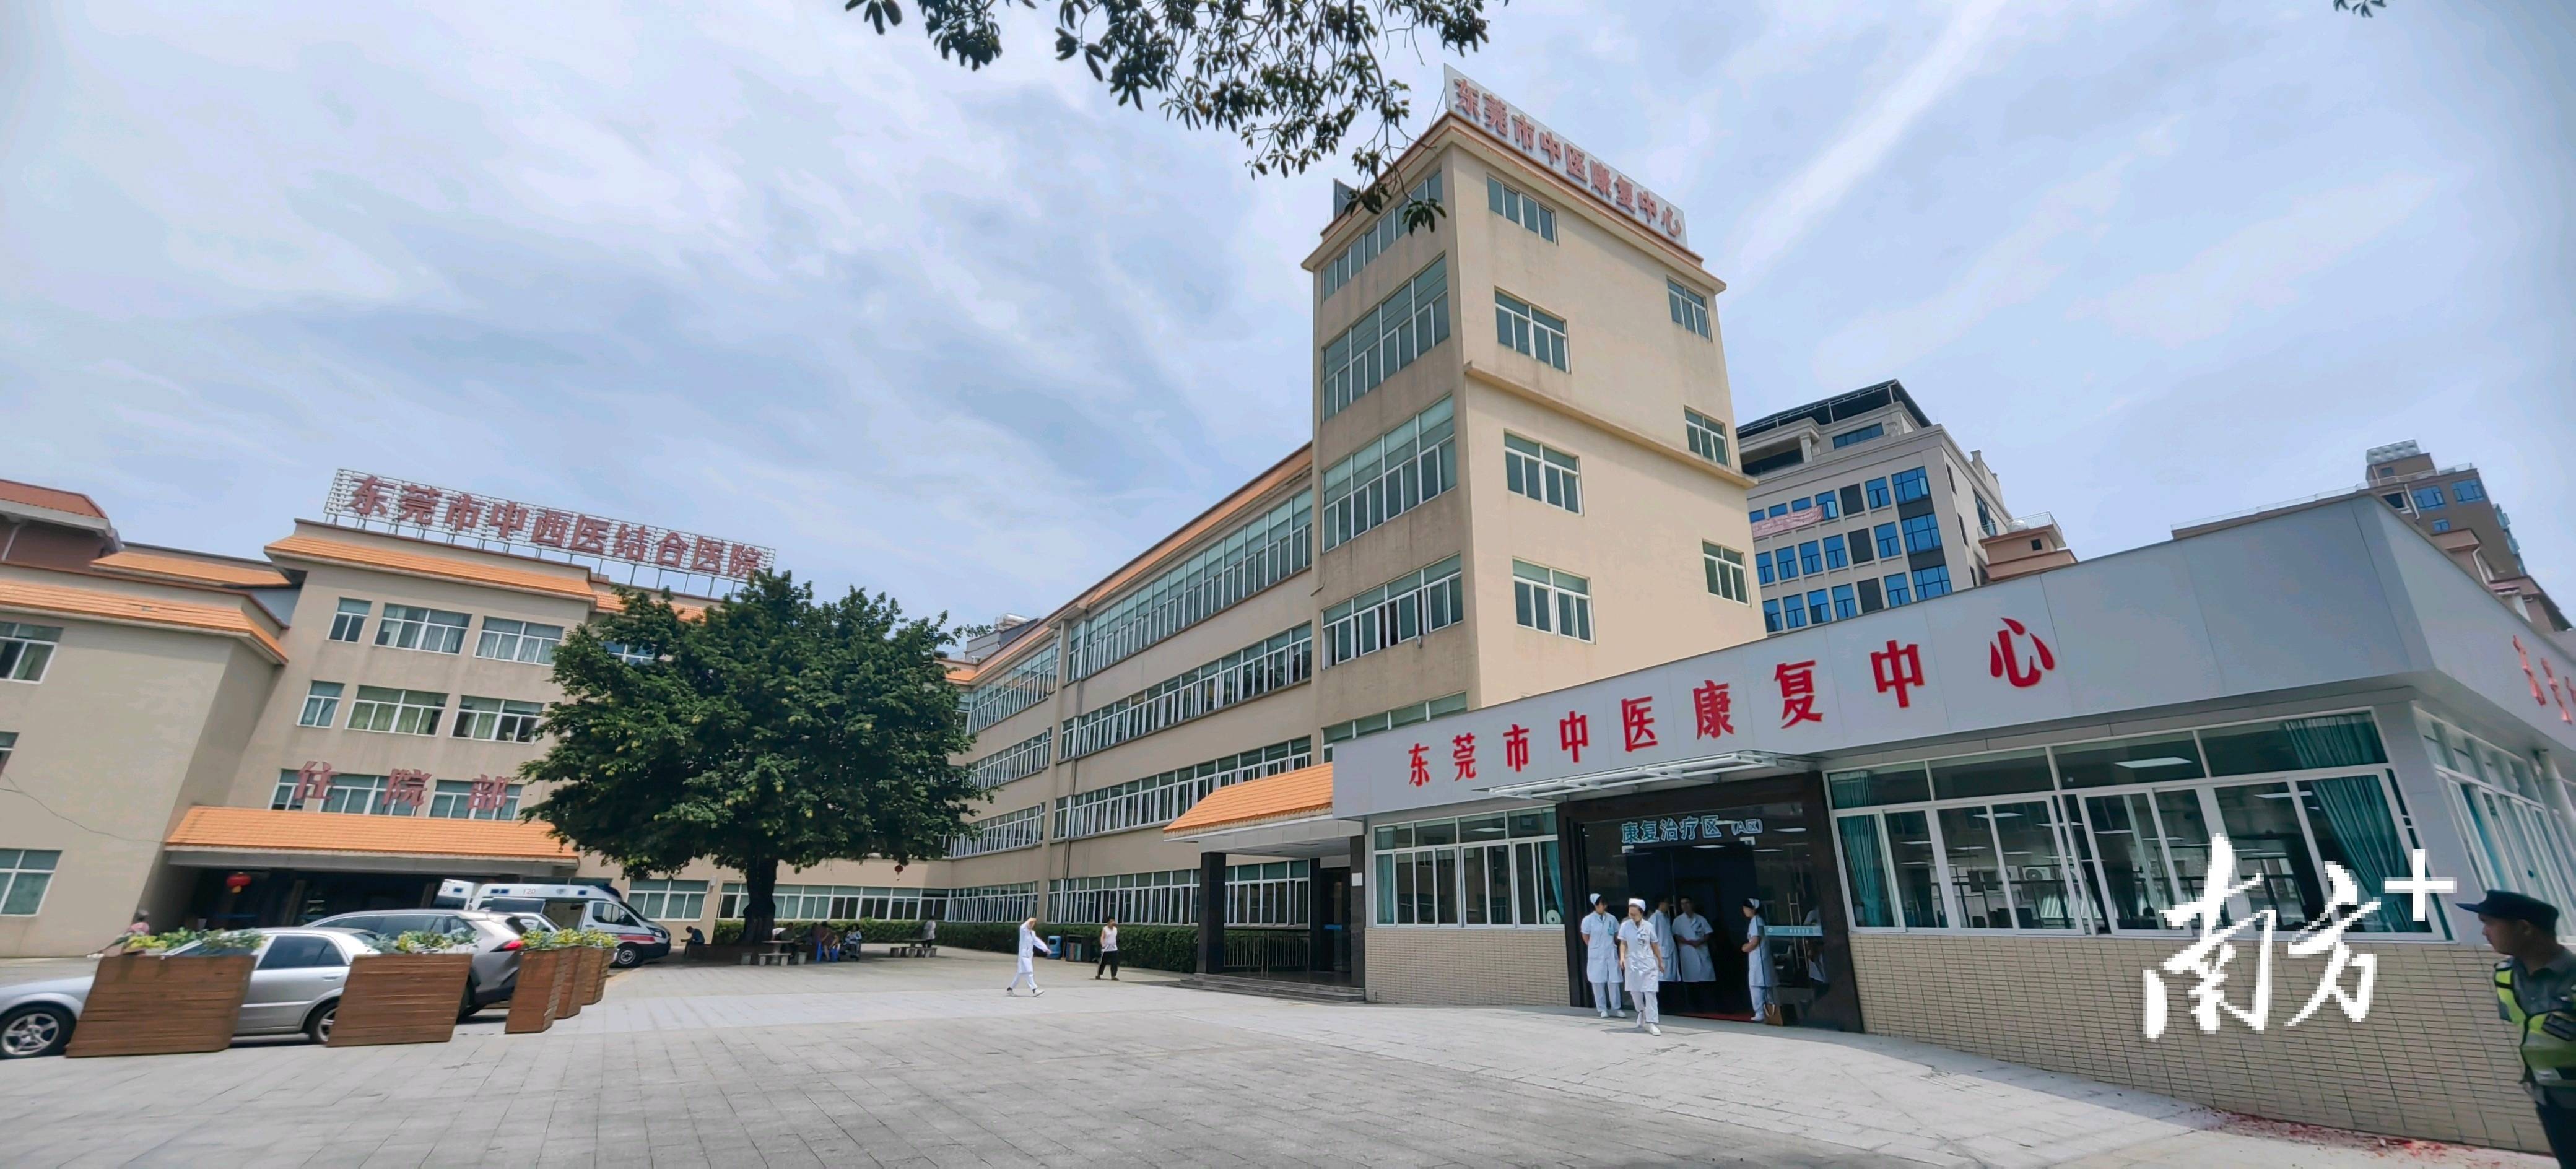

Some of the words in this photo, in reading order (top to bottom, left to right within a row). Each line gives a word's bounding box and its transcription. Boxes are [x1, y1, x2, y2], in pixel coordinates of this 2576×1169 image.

[1453, 78, 1682, 237] 东莞市中医康复中心
[345, 474, 763, 577] 东莞市中西医结合医院
[1408, 617, 2056, 786] 东莞市中医康复中心
[294, 760, 511, 811] 住院部
[1621, 815, 1722, 843] 康复治疗区
